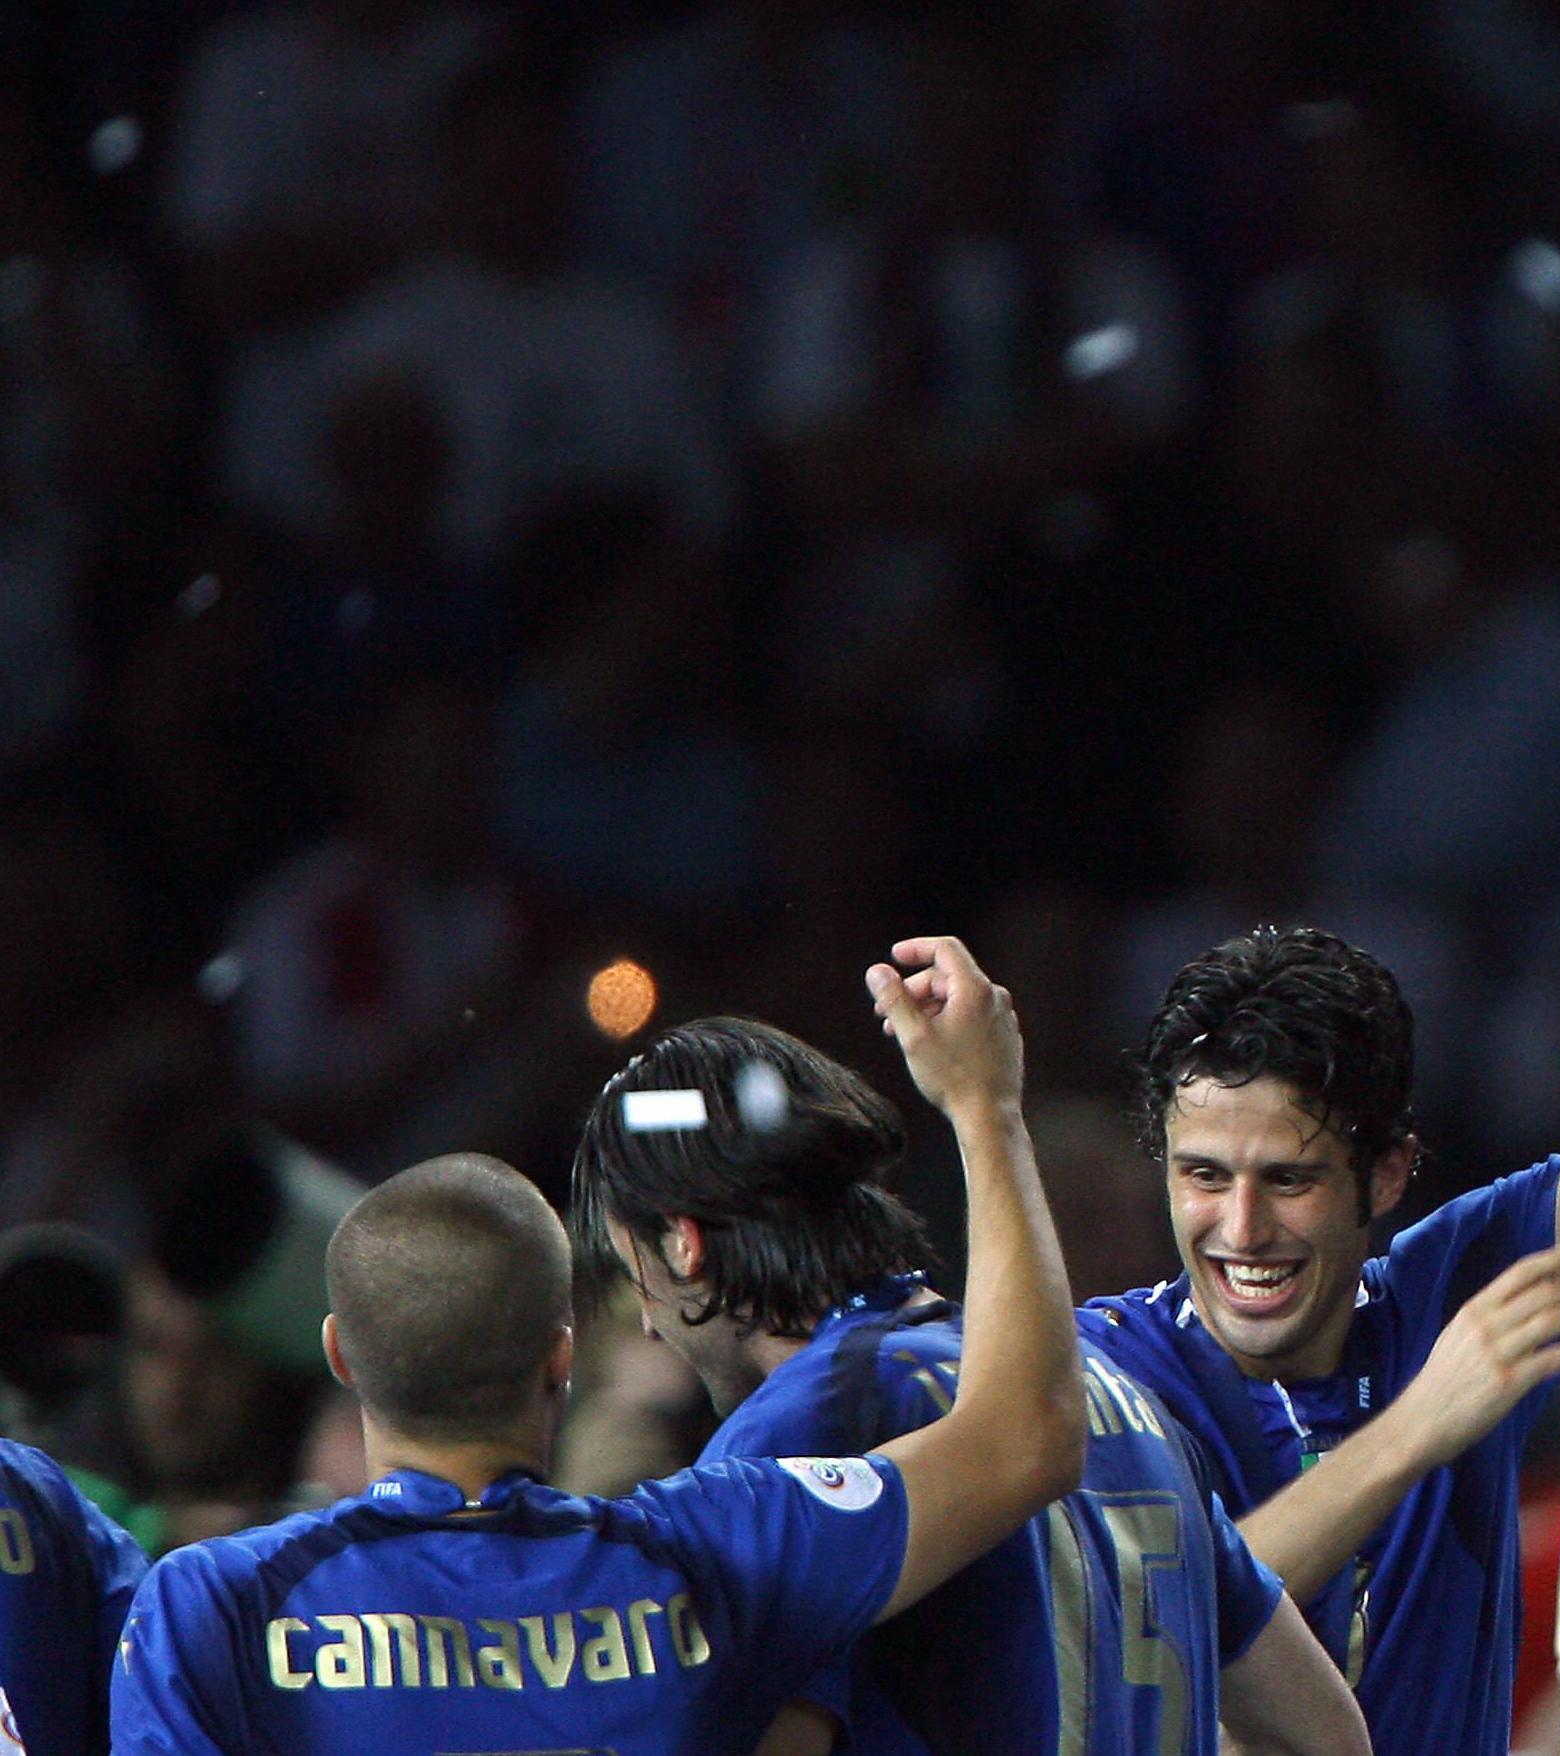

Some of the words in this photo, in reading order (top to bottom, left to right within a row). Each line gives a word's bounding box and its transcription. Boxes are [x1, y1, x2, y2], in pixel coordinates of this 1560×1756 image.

[1359, 1376, 1370, 1410] FIFA
[265, 1594, 711, 1690] cannavaro
[1046, 1488, 1192, 1756] 15
